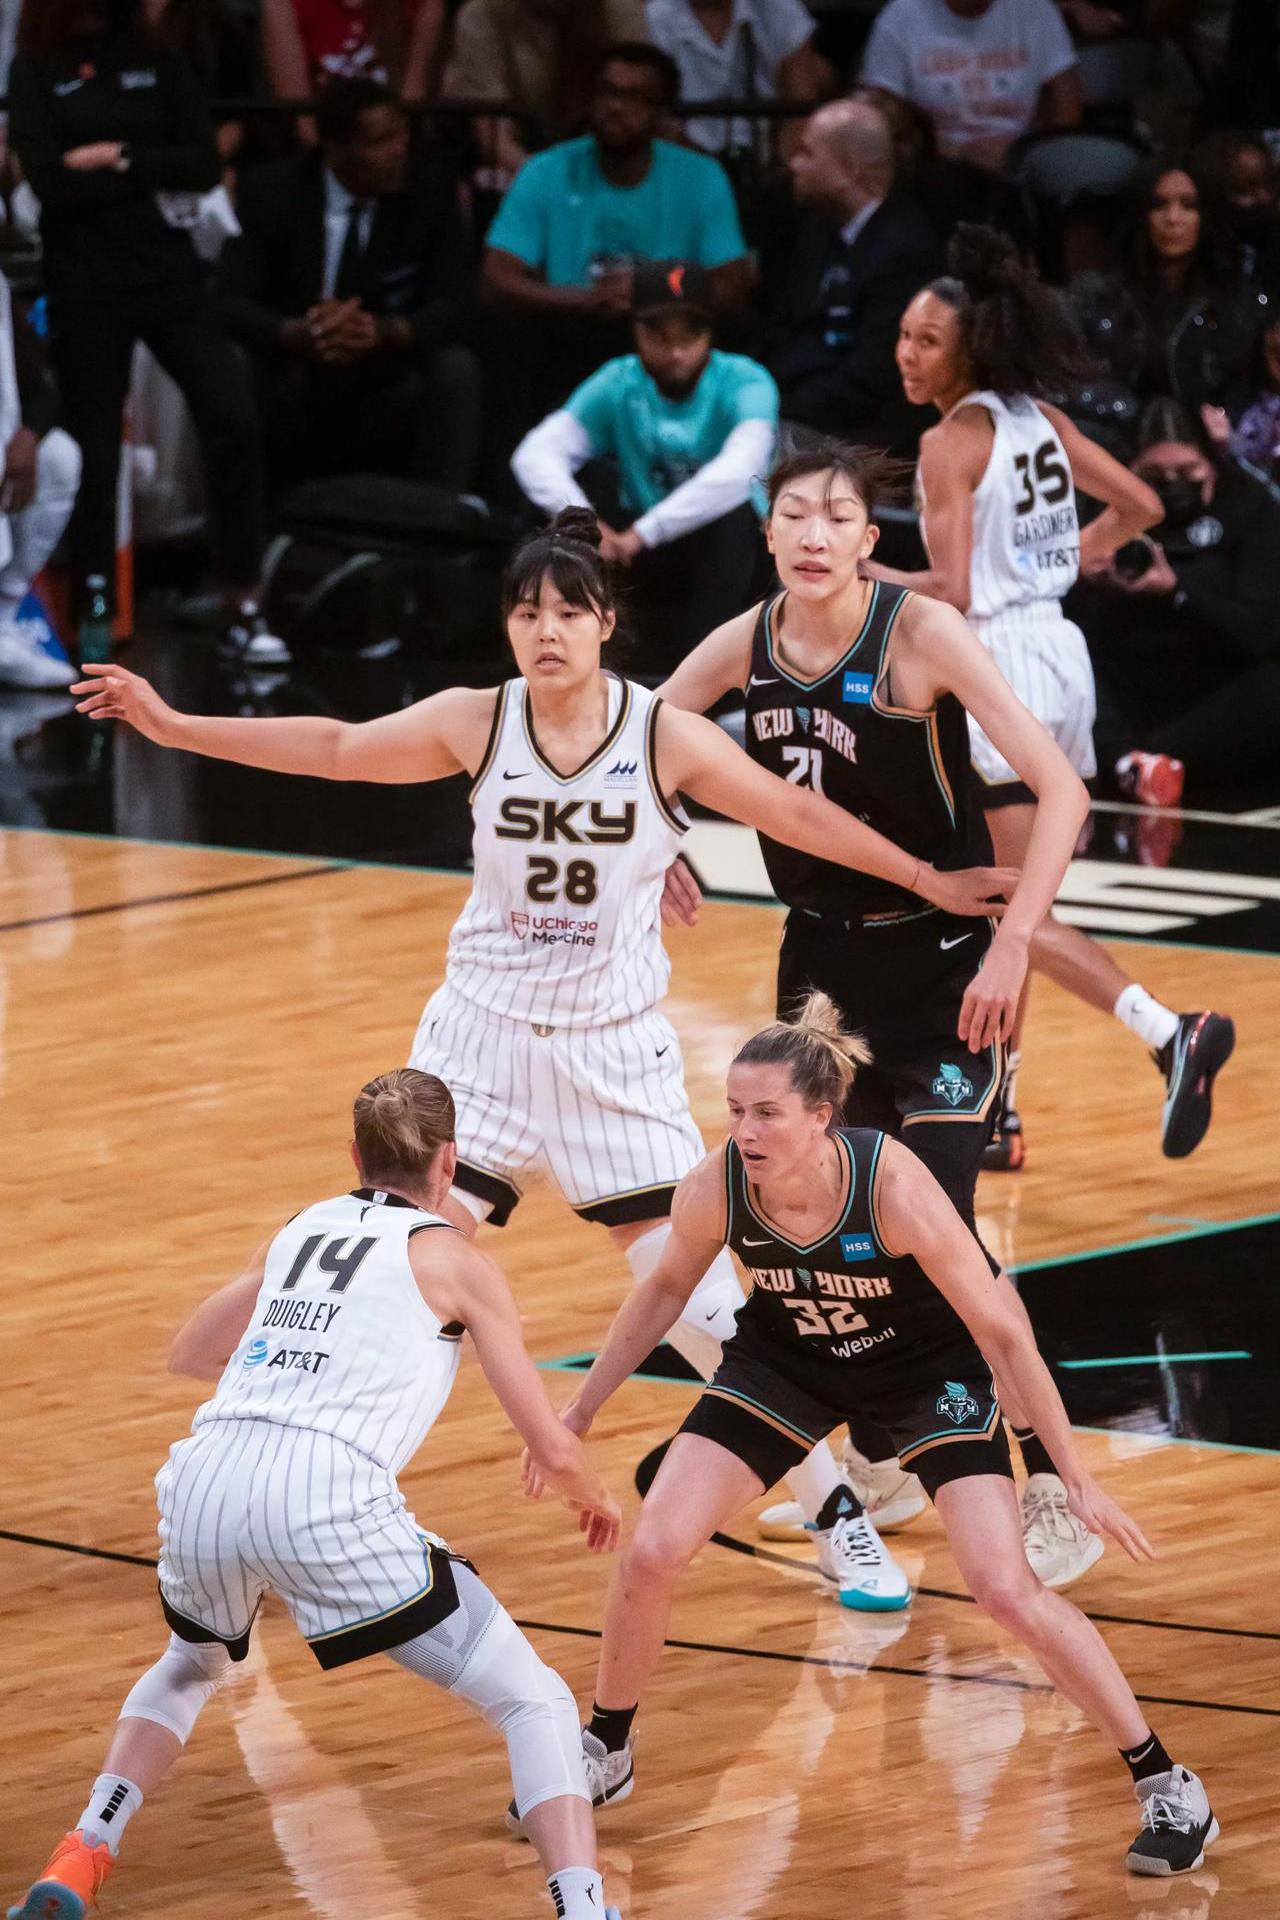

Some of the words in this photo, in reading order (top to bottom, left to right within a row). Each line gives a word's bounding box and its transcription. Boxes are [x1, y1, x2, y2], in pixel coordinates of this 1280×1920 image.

[1014, 440, 1069, 517] 35
[1013, 507, 1075, 548] GARDNER
[846, 682, 869, 694] HSS
[813, 707, 857, 764] YRK
[493, 795, 638, 845] SKY
[526, 855, 599, 907] 28
[532, 917, 598, 933] UChicgo
[532, 931, 596, 947] Mecine
[280, 1231, 380, 1294] 14
[845, 1241, 871, 1252] HSS
[814, 1270, 892, 1298] YORK
[262, 1299, 341, 1333] QUIGLEY
[782, 1298, 870, 1336] 32
[267, 1349, 329, 1374] AT&T
